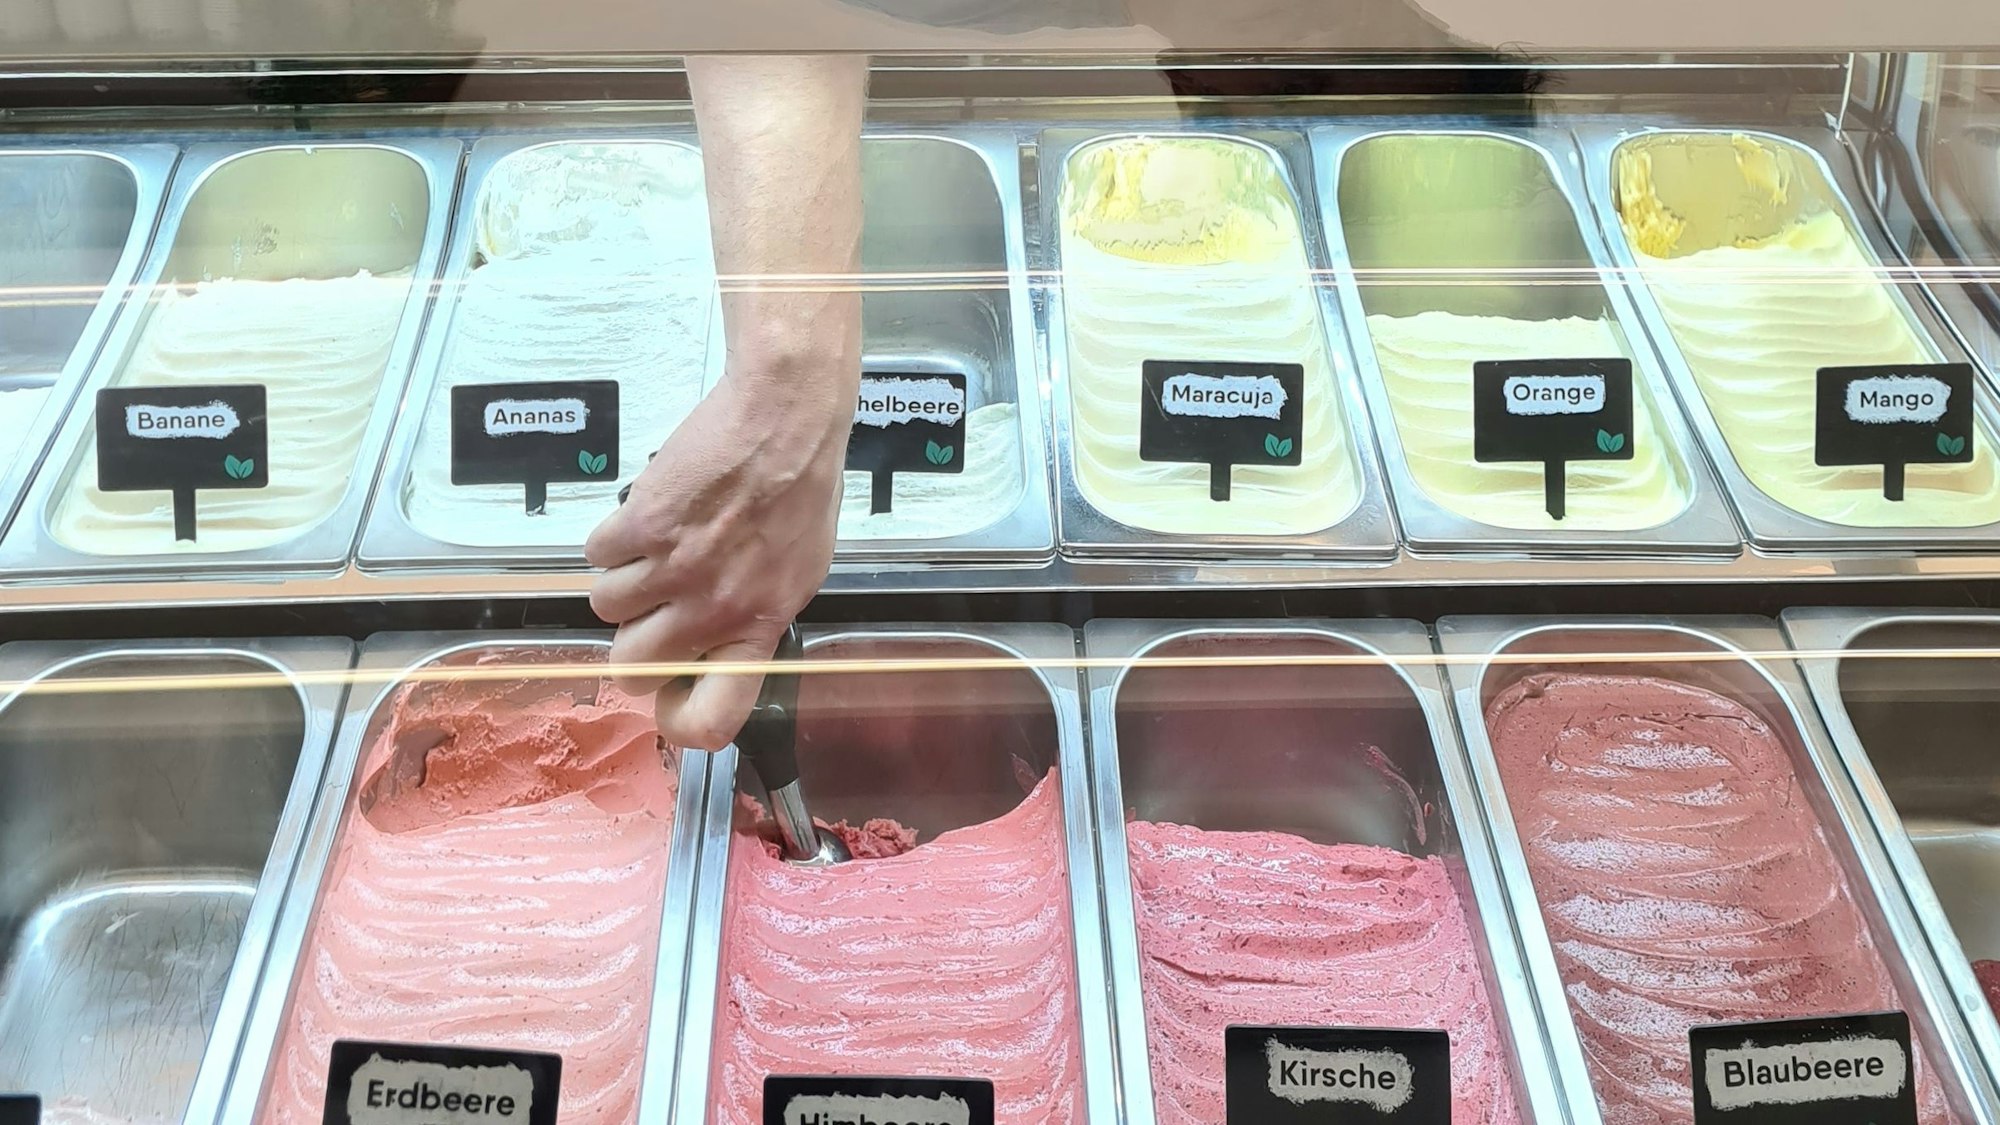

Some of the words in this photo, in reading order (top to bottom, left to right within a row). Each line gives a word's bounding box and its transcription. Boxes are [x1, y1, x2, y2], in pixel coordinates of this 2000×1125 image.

[857, 394, 960, 415] helbeere
[1172, 384, 1273, 409] Maracuja
[1513, 383, 1596, 405] Orange
[1860, 390, 1934, 411] Mango
[138, 411, 226, 430] Banane
[492, 408, 576, 425] Ananas
[1280, 1059, 1396, 1090] Kirsche
[1724, 1056, 1884, 1088] Blaubeere
[366, 1079, 515, 1116] Erdbeere
